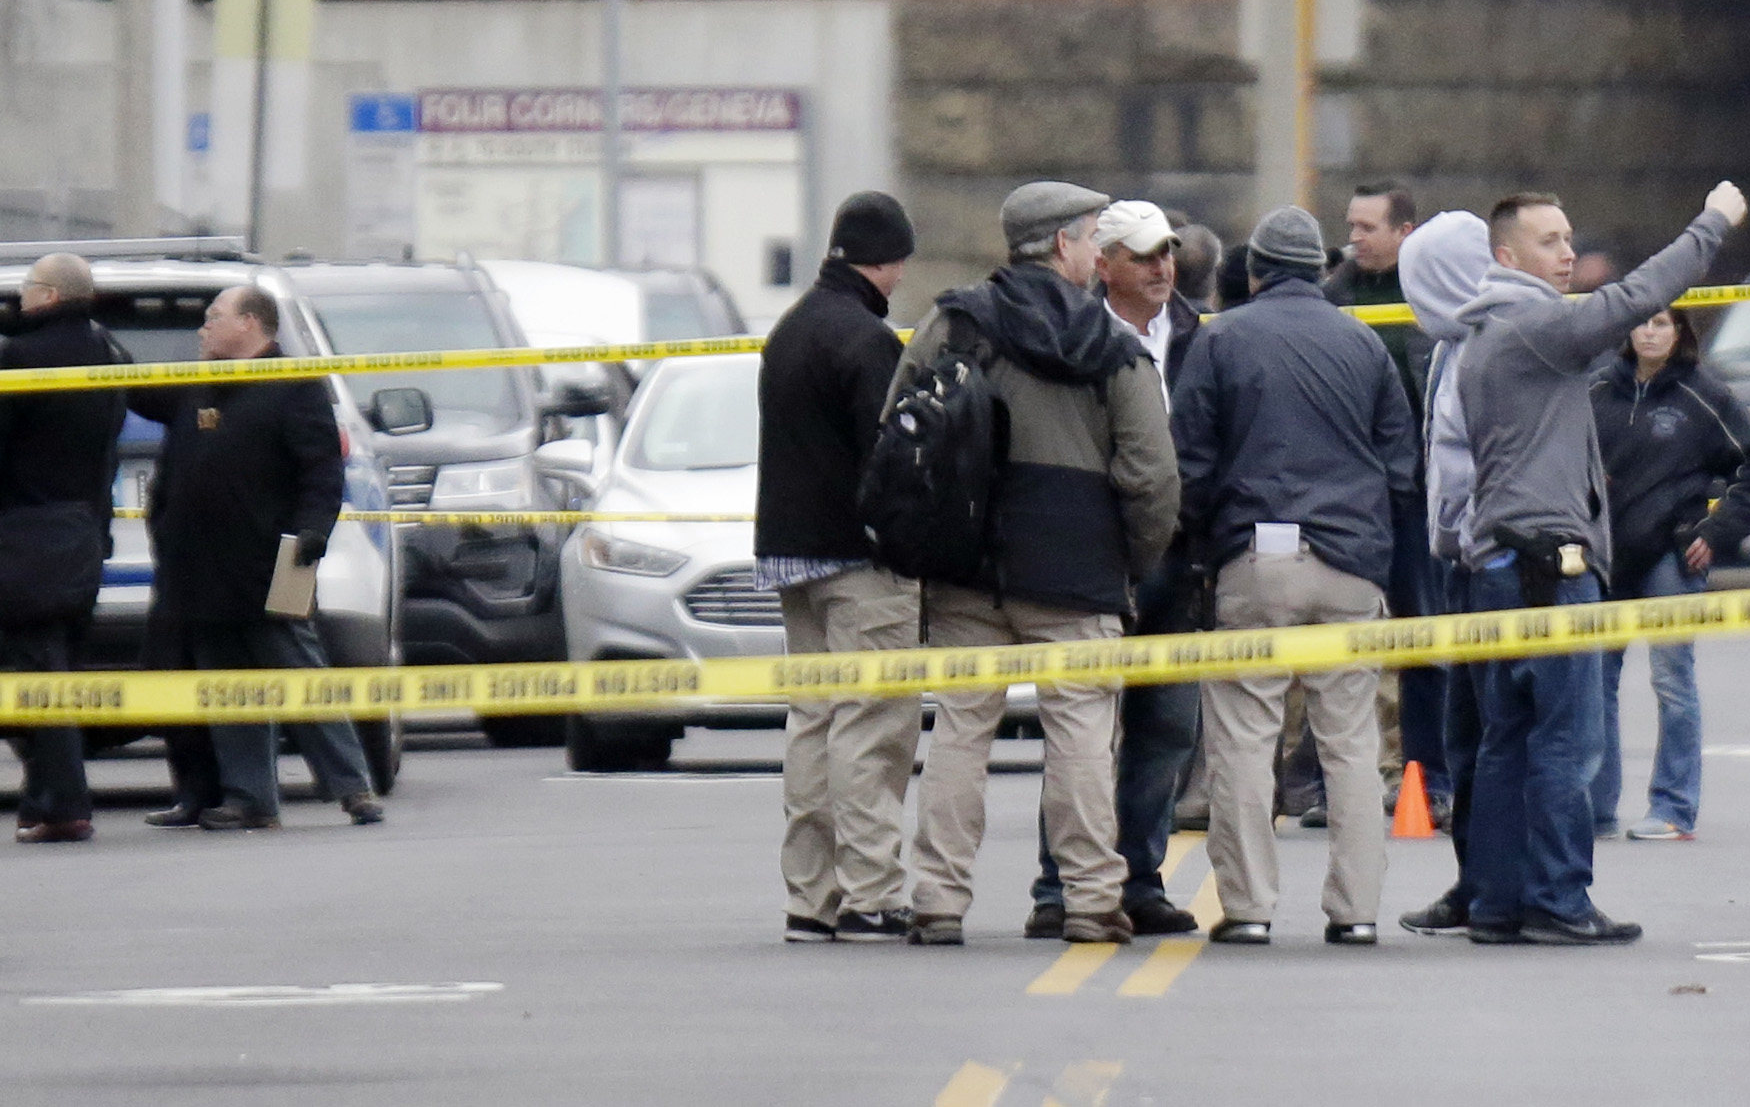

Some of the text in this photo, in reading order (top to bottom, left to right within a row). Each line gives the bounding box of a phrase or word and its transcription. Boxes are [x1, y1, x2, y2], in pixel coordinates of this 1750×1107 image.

[422, 92, 795, 125] FOUR CORNRS/GENEVA
[1514, 613, 1550, 640] DO
[1566, 607, 1621, 636] LINE
[1637, 595, 1725, 630] POLICE
[1346, 623, 1435, 655] CROSS
[1450, 618, 1501, 645] NOT
[771, 634, 1274, 689] BOSTON POLICE LINE DO NOT CROSS
[15, 677, 124, 710] BOSTON
[195, 663, 700, 708] BOSTON POLICE LINE DO NOT CROSS
